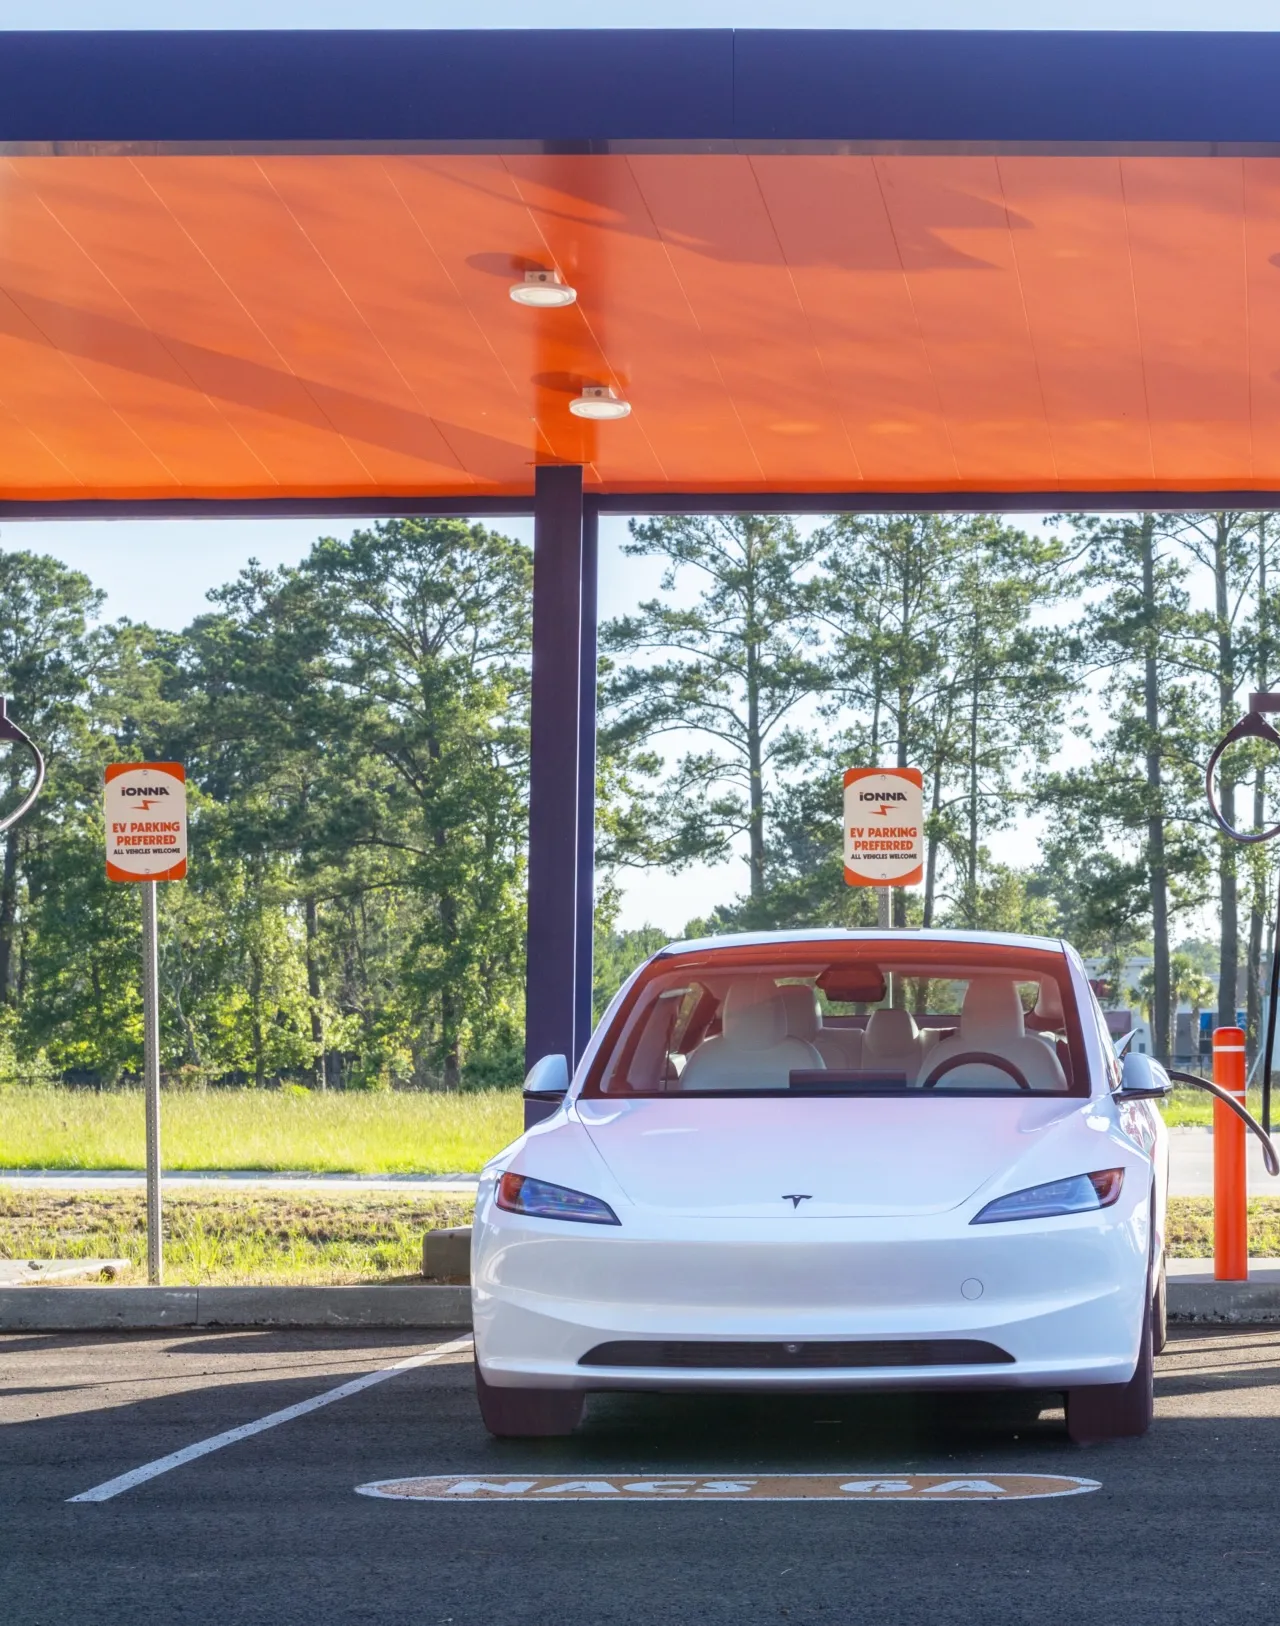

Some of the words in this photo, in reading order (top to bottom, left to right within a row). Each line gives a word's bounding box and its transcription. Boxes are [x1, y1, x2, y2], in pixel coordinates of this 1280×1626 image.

[112, 822, 127, 833] EV
[130, 822, 180, 833] PARKING
[850, 827, 864, 838] EV
[868, 827, 917, 838] PARKING
[116, 835, 176, 846] PREFERRED
[854, 840, 913, 851] PREFERRED
[445, 1480, 759, 1493] NACS
[840, 1480, 1009, 1493] 6A
